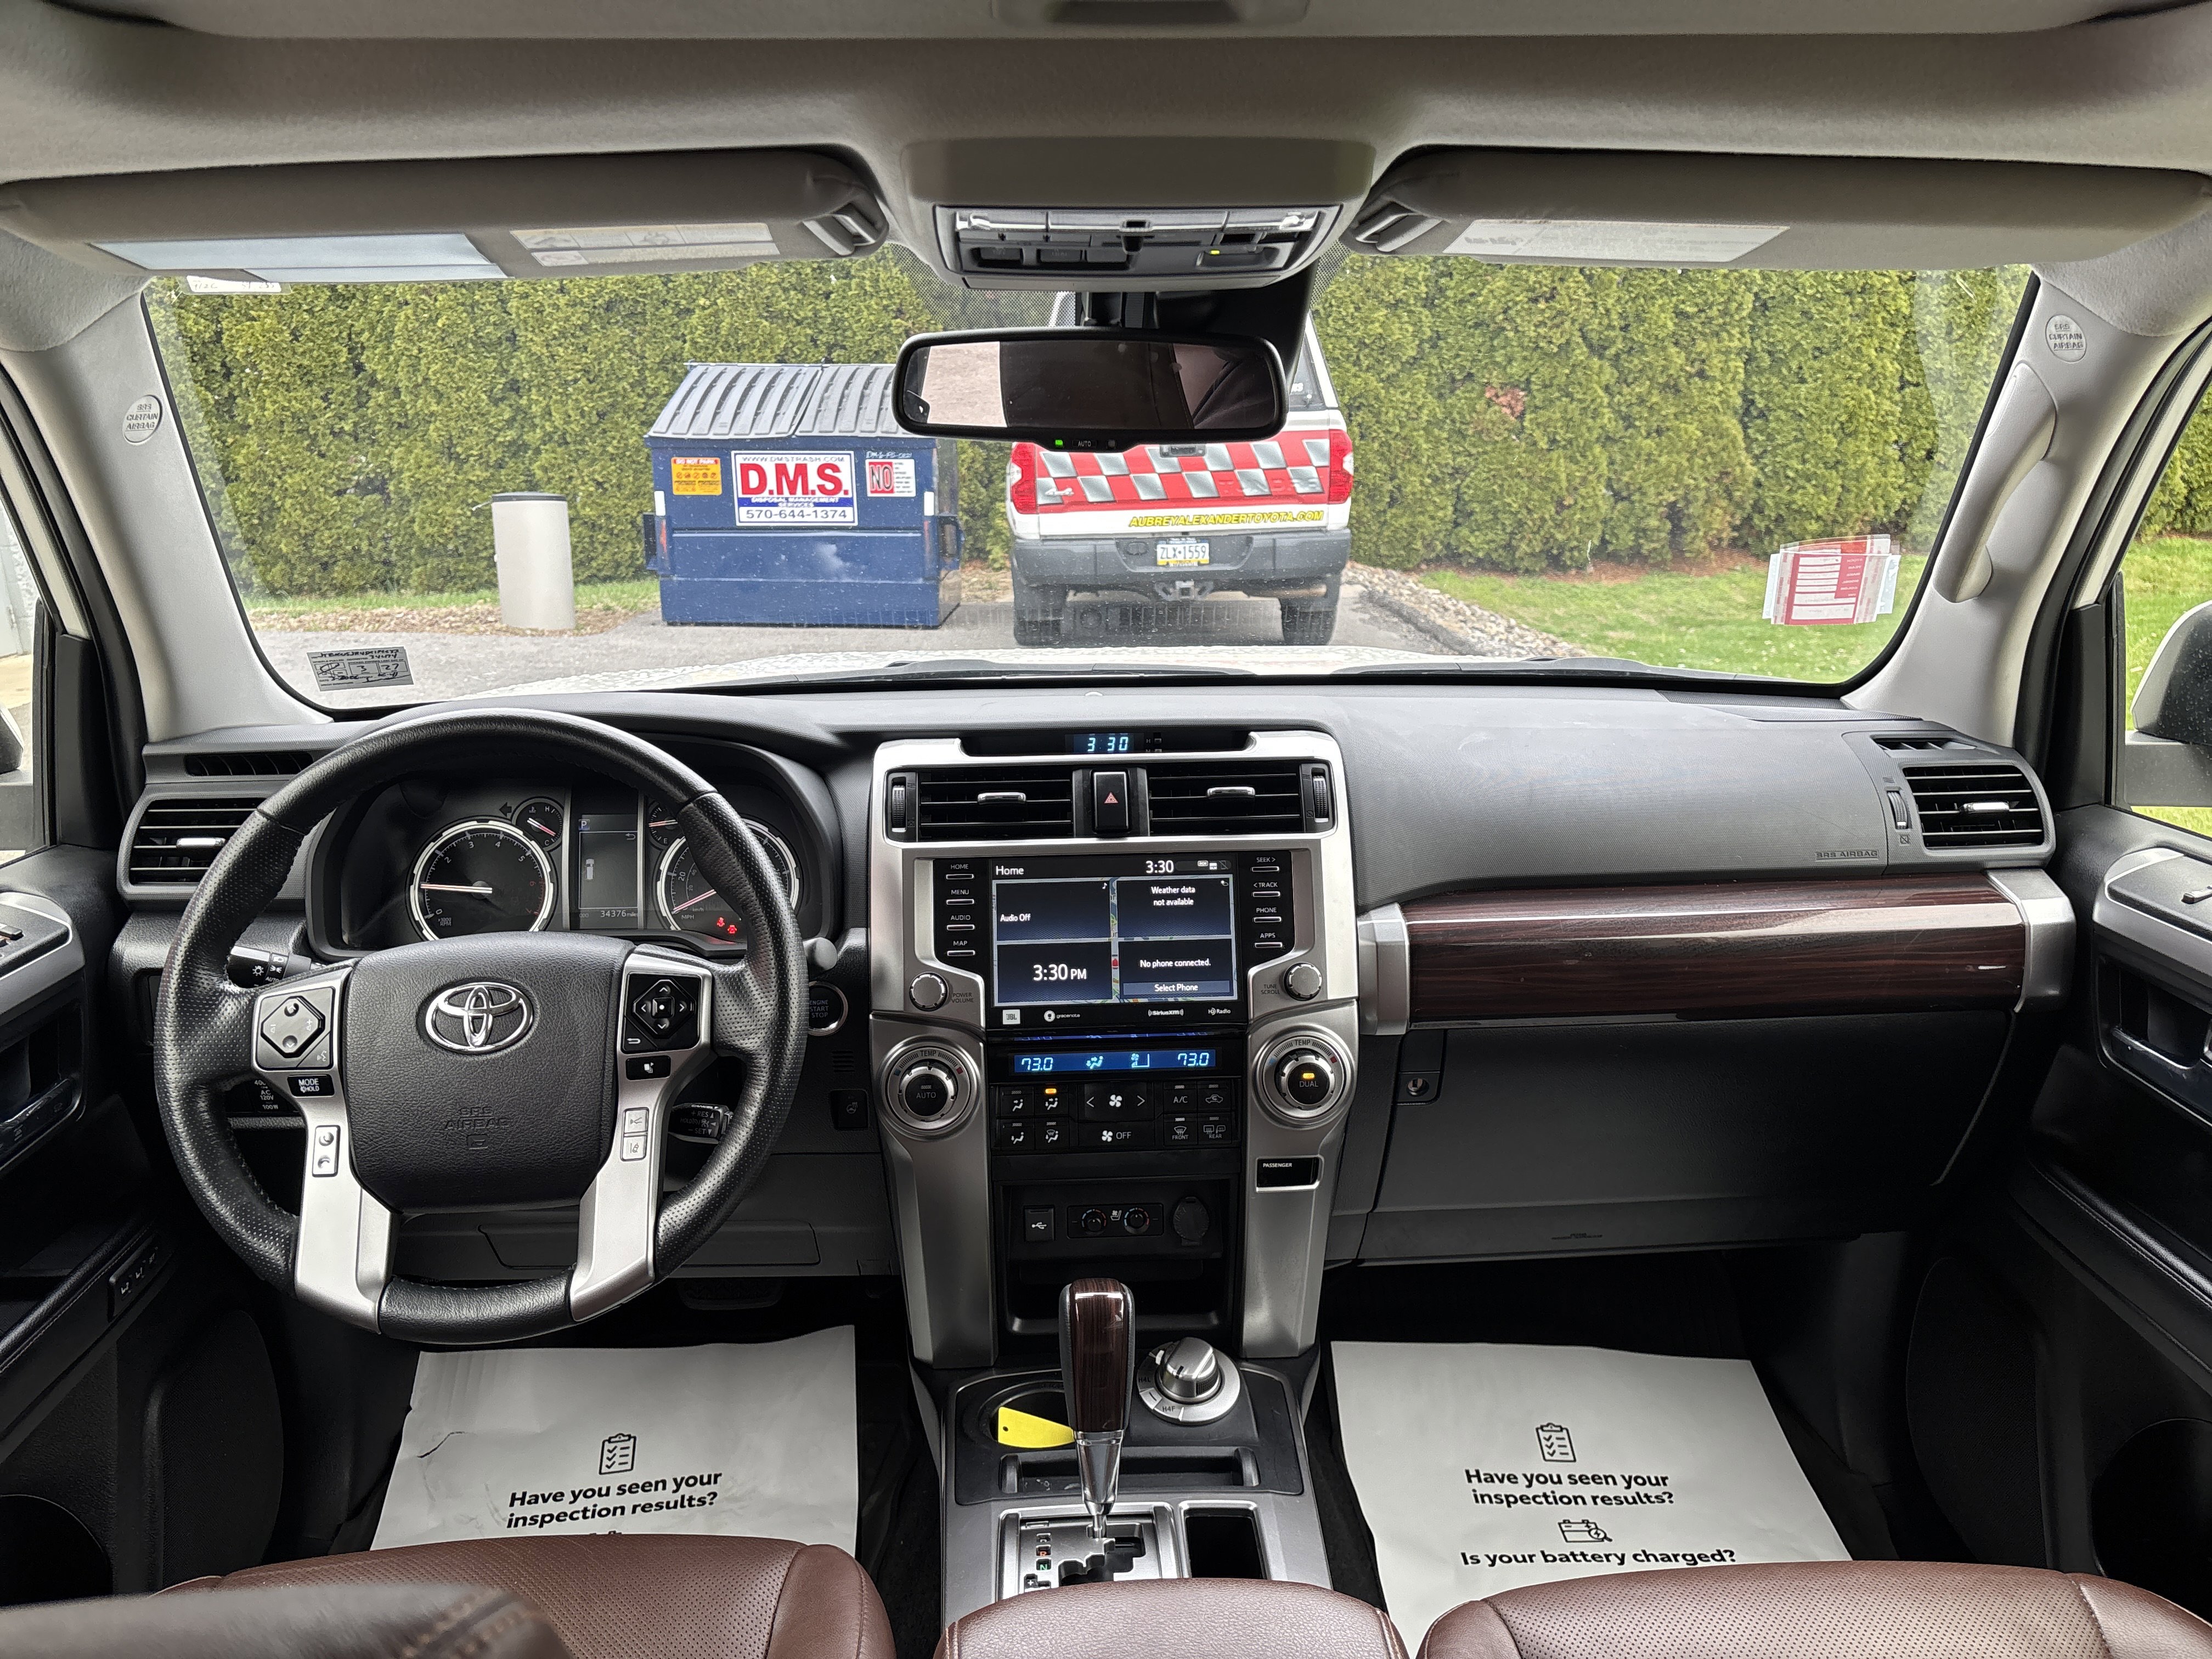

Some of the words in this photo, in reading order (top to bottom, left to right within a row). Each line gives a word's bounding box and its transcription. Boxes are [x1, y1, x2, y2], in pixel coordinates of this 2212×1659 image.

[740, 463, 849, 495] D.M.S.
[870, 465, 893, 490] NO
[746, 510, 847, 518] 570-644-1374
[1128, 511, 1324, 527] AUBREYALEXANDERTOYOTA.COM
[996, 866, 1024, 875] Home
[1146, 860, 1174, 873] 3:30
[678, 871, 686, 882] 20
[1019, 913, 1031, 922] Off
[1152, 960, 1173, 968] phone
[1175, 958, 1211, 967] connected.
[1033, 964, 1068, 981] 3:30
[1070, 968, 1087, 980] PM
[1022, 1057, 1053, 1071] 73.0
[1178, 1052, 1210, 1066] 73.0
[298, 1078, 319, 1086] MODE
[444, 1118, 510, 1130] AIRBAG
[1116, 1131, 1132, 1139] OFF
[1465, 1469, 1519, 1484] Have
[1522, 1471, 1562, 1488] you
[1567, 1471, 1617, 1486] seen
[1620, 1474, 1669, 1489] your
[509, 1491, 565, 1508] Have
[569, 1485, 611, 1505] you
[616, 1479, 667, 1496] seen
[672, 1472, 723, 1493] your
[1471, 1489, 1587, 1508] inspection
[1592, 1491, 1674, 1506] results?
[506, 1503, 625, 1529] inspection
[631, 1491, 718, 1515] results?
[1461, 1551, 1481, 1566] Is
[1484, 1553, 1537, 1567] your
[1540, 1550, 1626, 1566] battery
[1632, 1549, 1736, 1566] charged?
